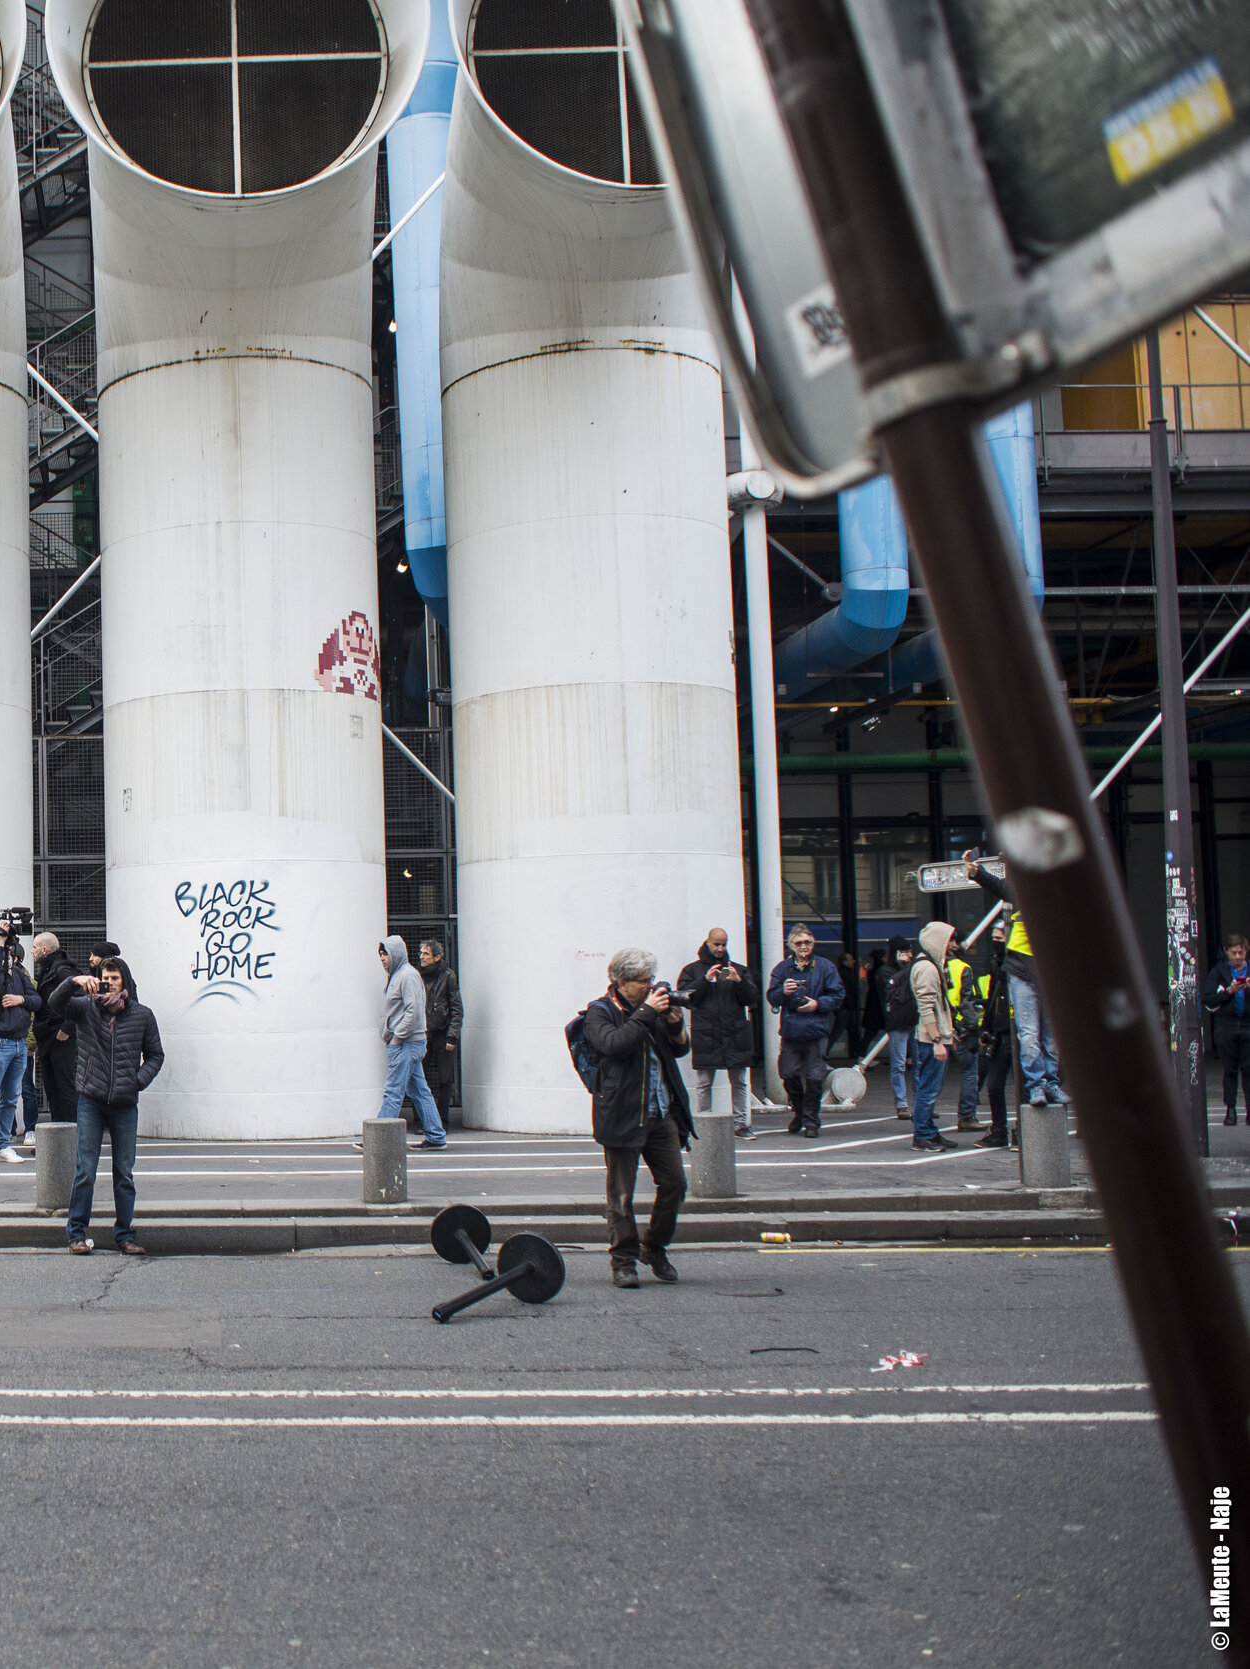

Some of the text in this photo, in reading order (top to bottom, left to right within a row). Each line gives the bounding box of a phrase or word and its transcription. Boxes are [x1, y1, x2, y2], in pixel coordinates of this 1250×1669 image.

[175, 880, 276, 917] BLACK
[200, 905, 282, 937] ROCK
[205, 931, 253, 956] GO
[191, 951, 276, 981] HOME
